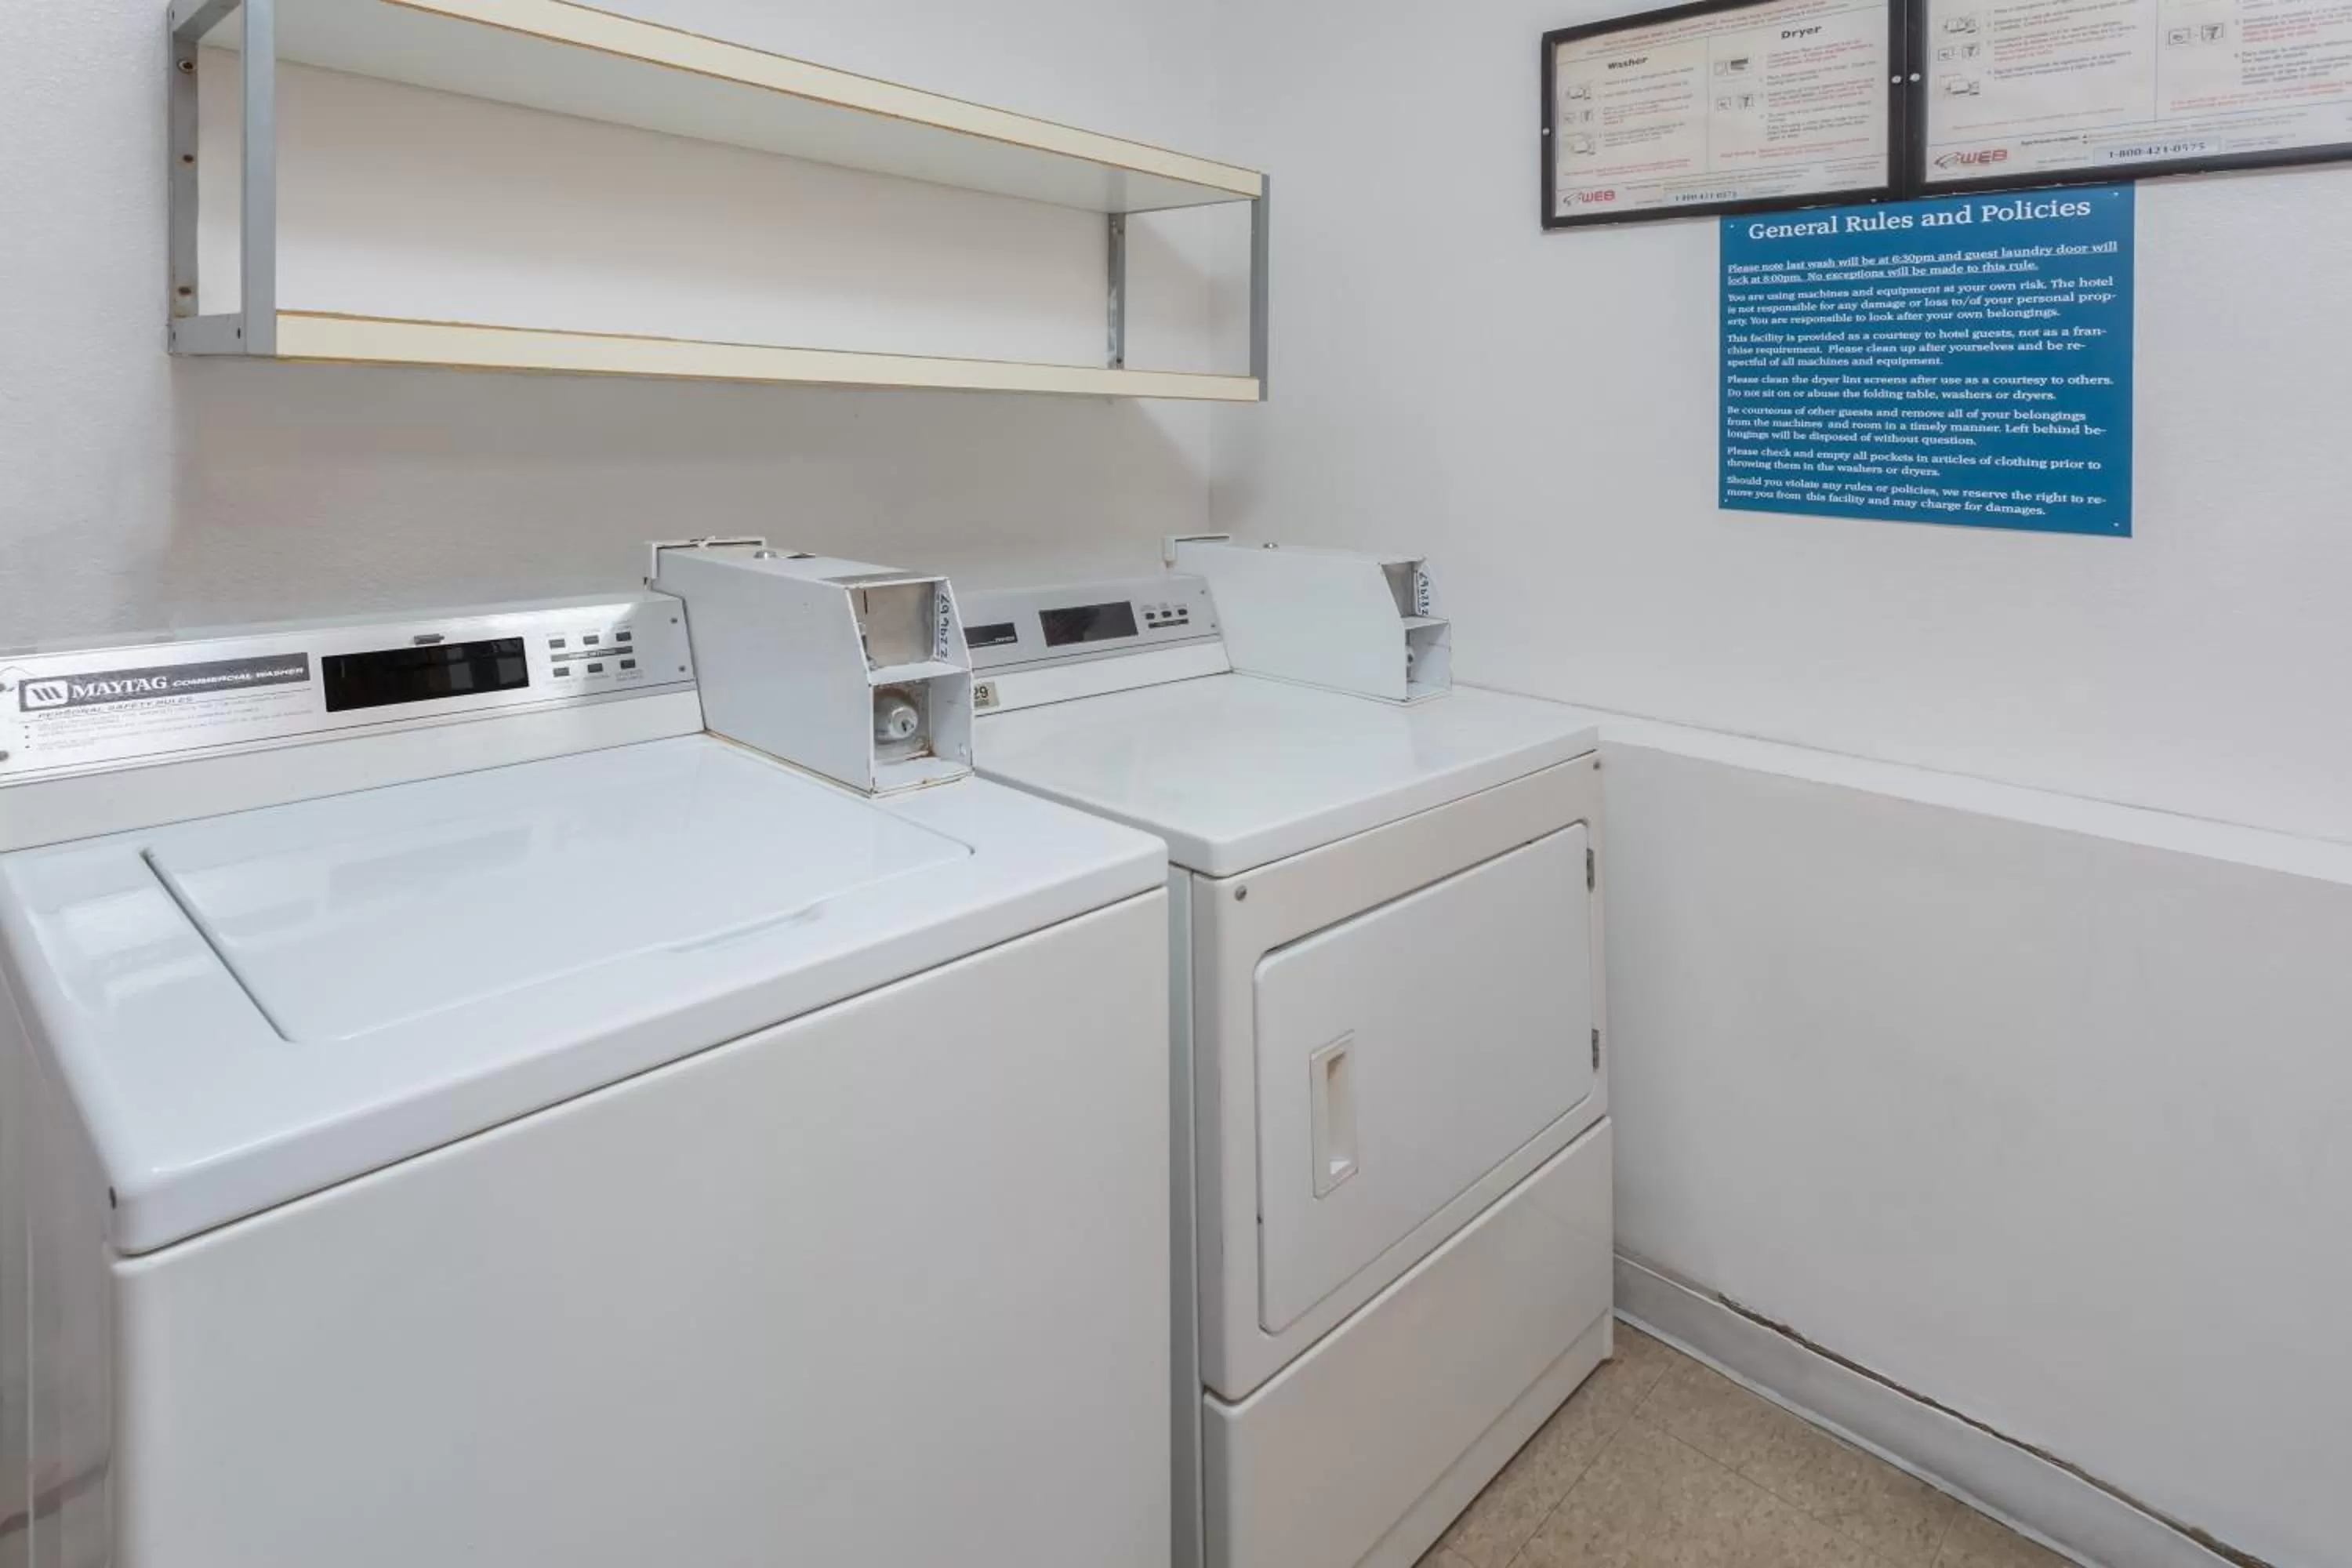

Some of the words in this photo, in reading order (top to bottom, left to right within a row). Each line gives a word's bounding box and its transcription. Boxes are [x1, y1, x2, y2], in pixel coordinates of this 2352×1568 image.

[1780, 25, 1823, 39] Dryer
[1748, 216, 1838, 241] General
[1846, 209, 1914, 234] Rules
[1920, 205, 1972, 228] and
[1981, 195, 2091, 224] Policies
[1878, 255, 1889, 264] at
[1936, 250, 1962, 261] and
[1963, 249, 1998, 262] guest
[2001, 245, 2053, 260] laundry
[2054, 242, 2089, 255] door
[2091, 241, 2118, 252] will
[1886, 267, 1909, 277] will
[1911, 265, 1927, 276] be
[1929, 263, 1964, 275] made
[1966, 263, 1980, 273] to
[1981, 261, 2007, 272] this
[1875, 284, 1941, 298] equipment
[1943, 284, 1955, 292] at
[1957, 284, 1987, 295] your
[1988, 282, 2016, 291] own
[2049, 277, 2075, 289] The
[2078, 275, 2114, 287] hotel
[1860, 298, 1906, 311] damage
[1924, 296, 1949, 307] loss
[1951, 295, 1982, 308] to/of
[1984, 296, 2014, 307] your
[2016, 291, 2075, 306] personal
[2077, 292, 2116, 303] prop-
[1867, 311, 1894, 321] look
[1896, 310, 1923, 321] after
[1926, 312, 1953, 322] your
[1872, 330, 1922, 343] courtesy
[1923, 330, 1936, 339] to
[1938, 328, 1969, 339] hotel
[2017, 328, 2040, 337] not
[2072, 325, 2107, 336] fran-
[1865, 343, 1897, 353] clean
[1900, 345, 1916, 354] up
[1918, 342, 1947, 352] after
[1947, 341, 2015, 354] yourselves
[2016, 340, 2044, 350] and
[2045, 339, 2064, 350] be
[2066, 342, 2086, 350] re-
[1909, 374, 1938, 384] after
[1991, 376, 2049, 387] courtesy
[2049, 376, 2065, 384] to
[1862, 388, 1904, 401] folding
[1940, 389, 1993, 399] washers
[1875, 407, 1899, 417] and
[1947, 408, 1964, 418] all
[1965, 408, 1980, 419] of
[1980, 411, 2012, 422] your
[2013, 409, 2087, 423] belongings
[1884, 421, 1896, 430] in
[1909, 420, 1947, 434] timely
[2004, 423, 2030, 434] Left
[2031, 423, 2081, 434] behind
[2082, 424, 2107, 435] be-
[1873, 432, 1919, 443] without
[1869, 451, 1915, 465] pockets
[1915, 453, 1929, 463] in
[1930, 453, 1977, 465] articles
[1977, 455, 1993, 466] of
[1993, 456, 2049, 470] clothing
[2049, 458, 2085, 472] prior
[2086, 460, 2102, 470] to
[1867, 495, 1890, 506] and
[1892, 499, 1918, 510] may
[1919, 498, 1962, 512] charge
[1963, 500, 1983, 511] for
[1962, 489, 2009, 499] reserve
[2010, 489, 2033, 500] the
[2034, 491, 2068, 505] right
[2069, 493, 2085, 503] to
[2085, 495, 2107, 505] re-
[72, 675, 168, 699] MAYTAG
[172, 673, 252, 687] COMMERCIAL
[256, 667, 304, 679] WASHER
